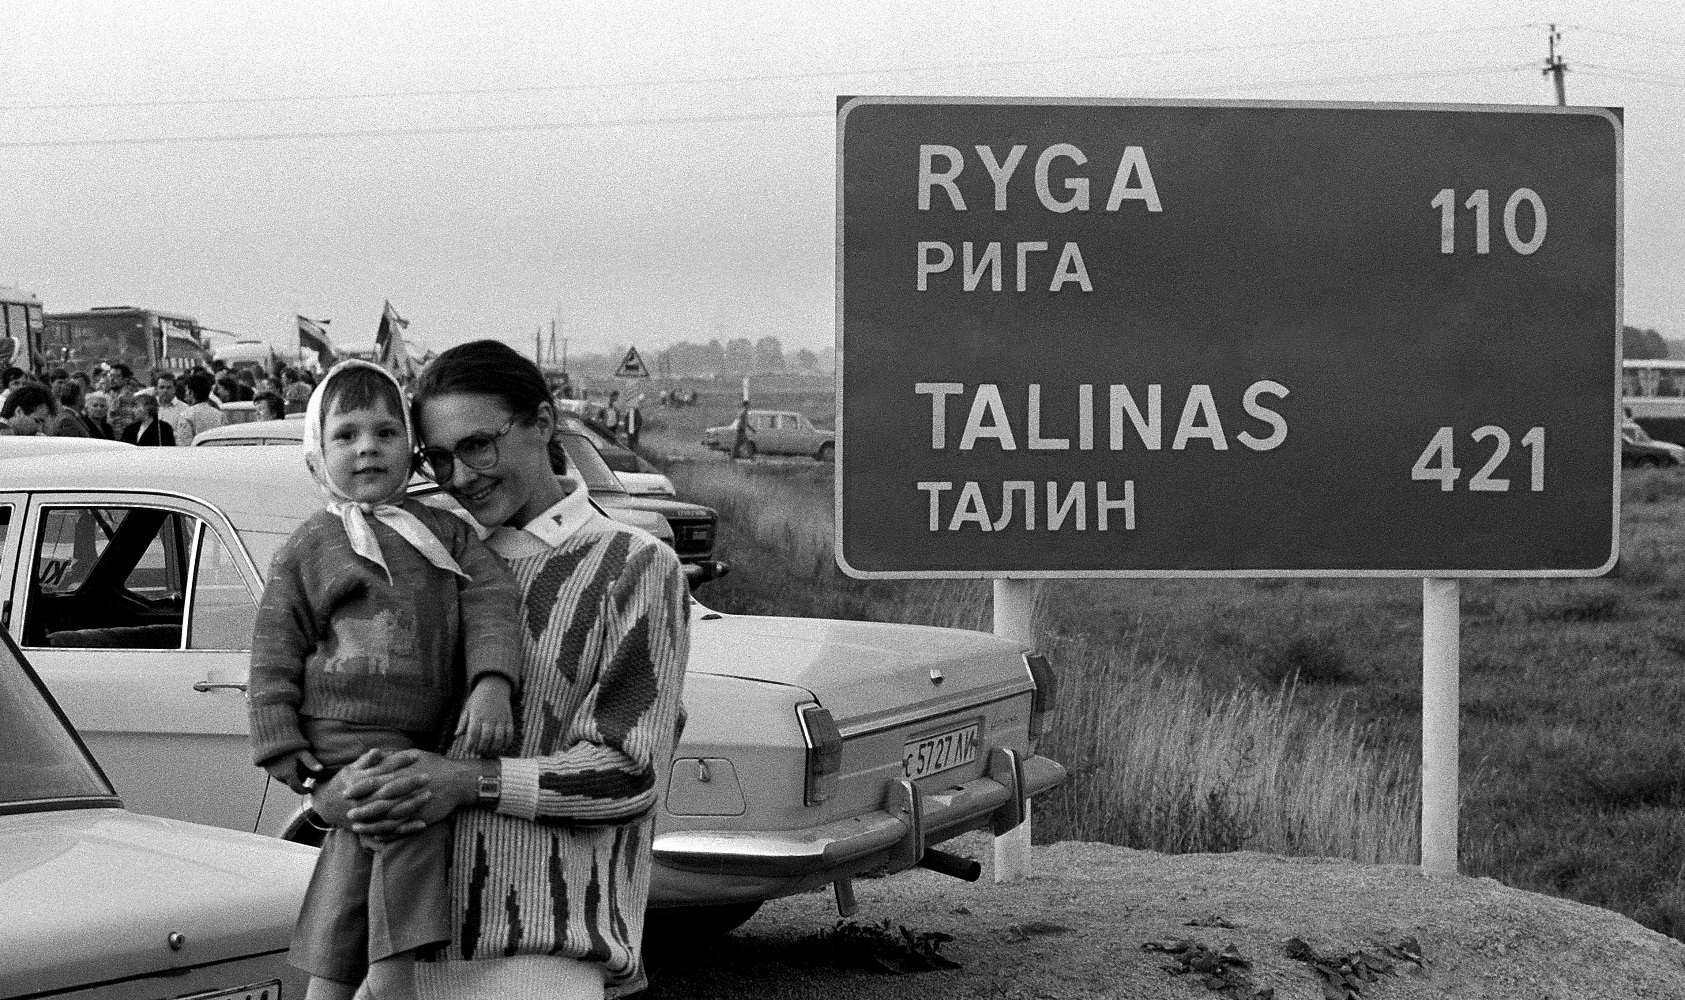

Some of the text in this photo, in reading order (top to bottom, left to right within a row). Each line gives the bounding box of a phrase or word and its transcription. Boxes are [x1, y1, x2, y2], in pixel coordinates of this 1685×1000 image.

[917, 142, 1163, 213] RYGA
[1431, 187, 1548, 255] 110
[916, 241, 1093, 292] РИГА
[914, 379, 1291, 451] TALINAS
[1411, 425, 1546, 491] 421
[917, 480, 1136, 532] ТАЛИН
